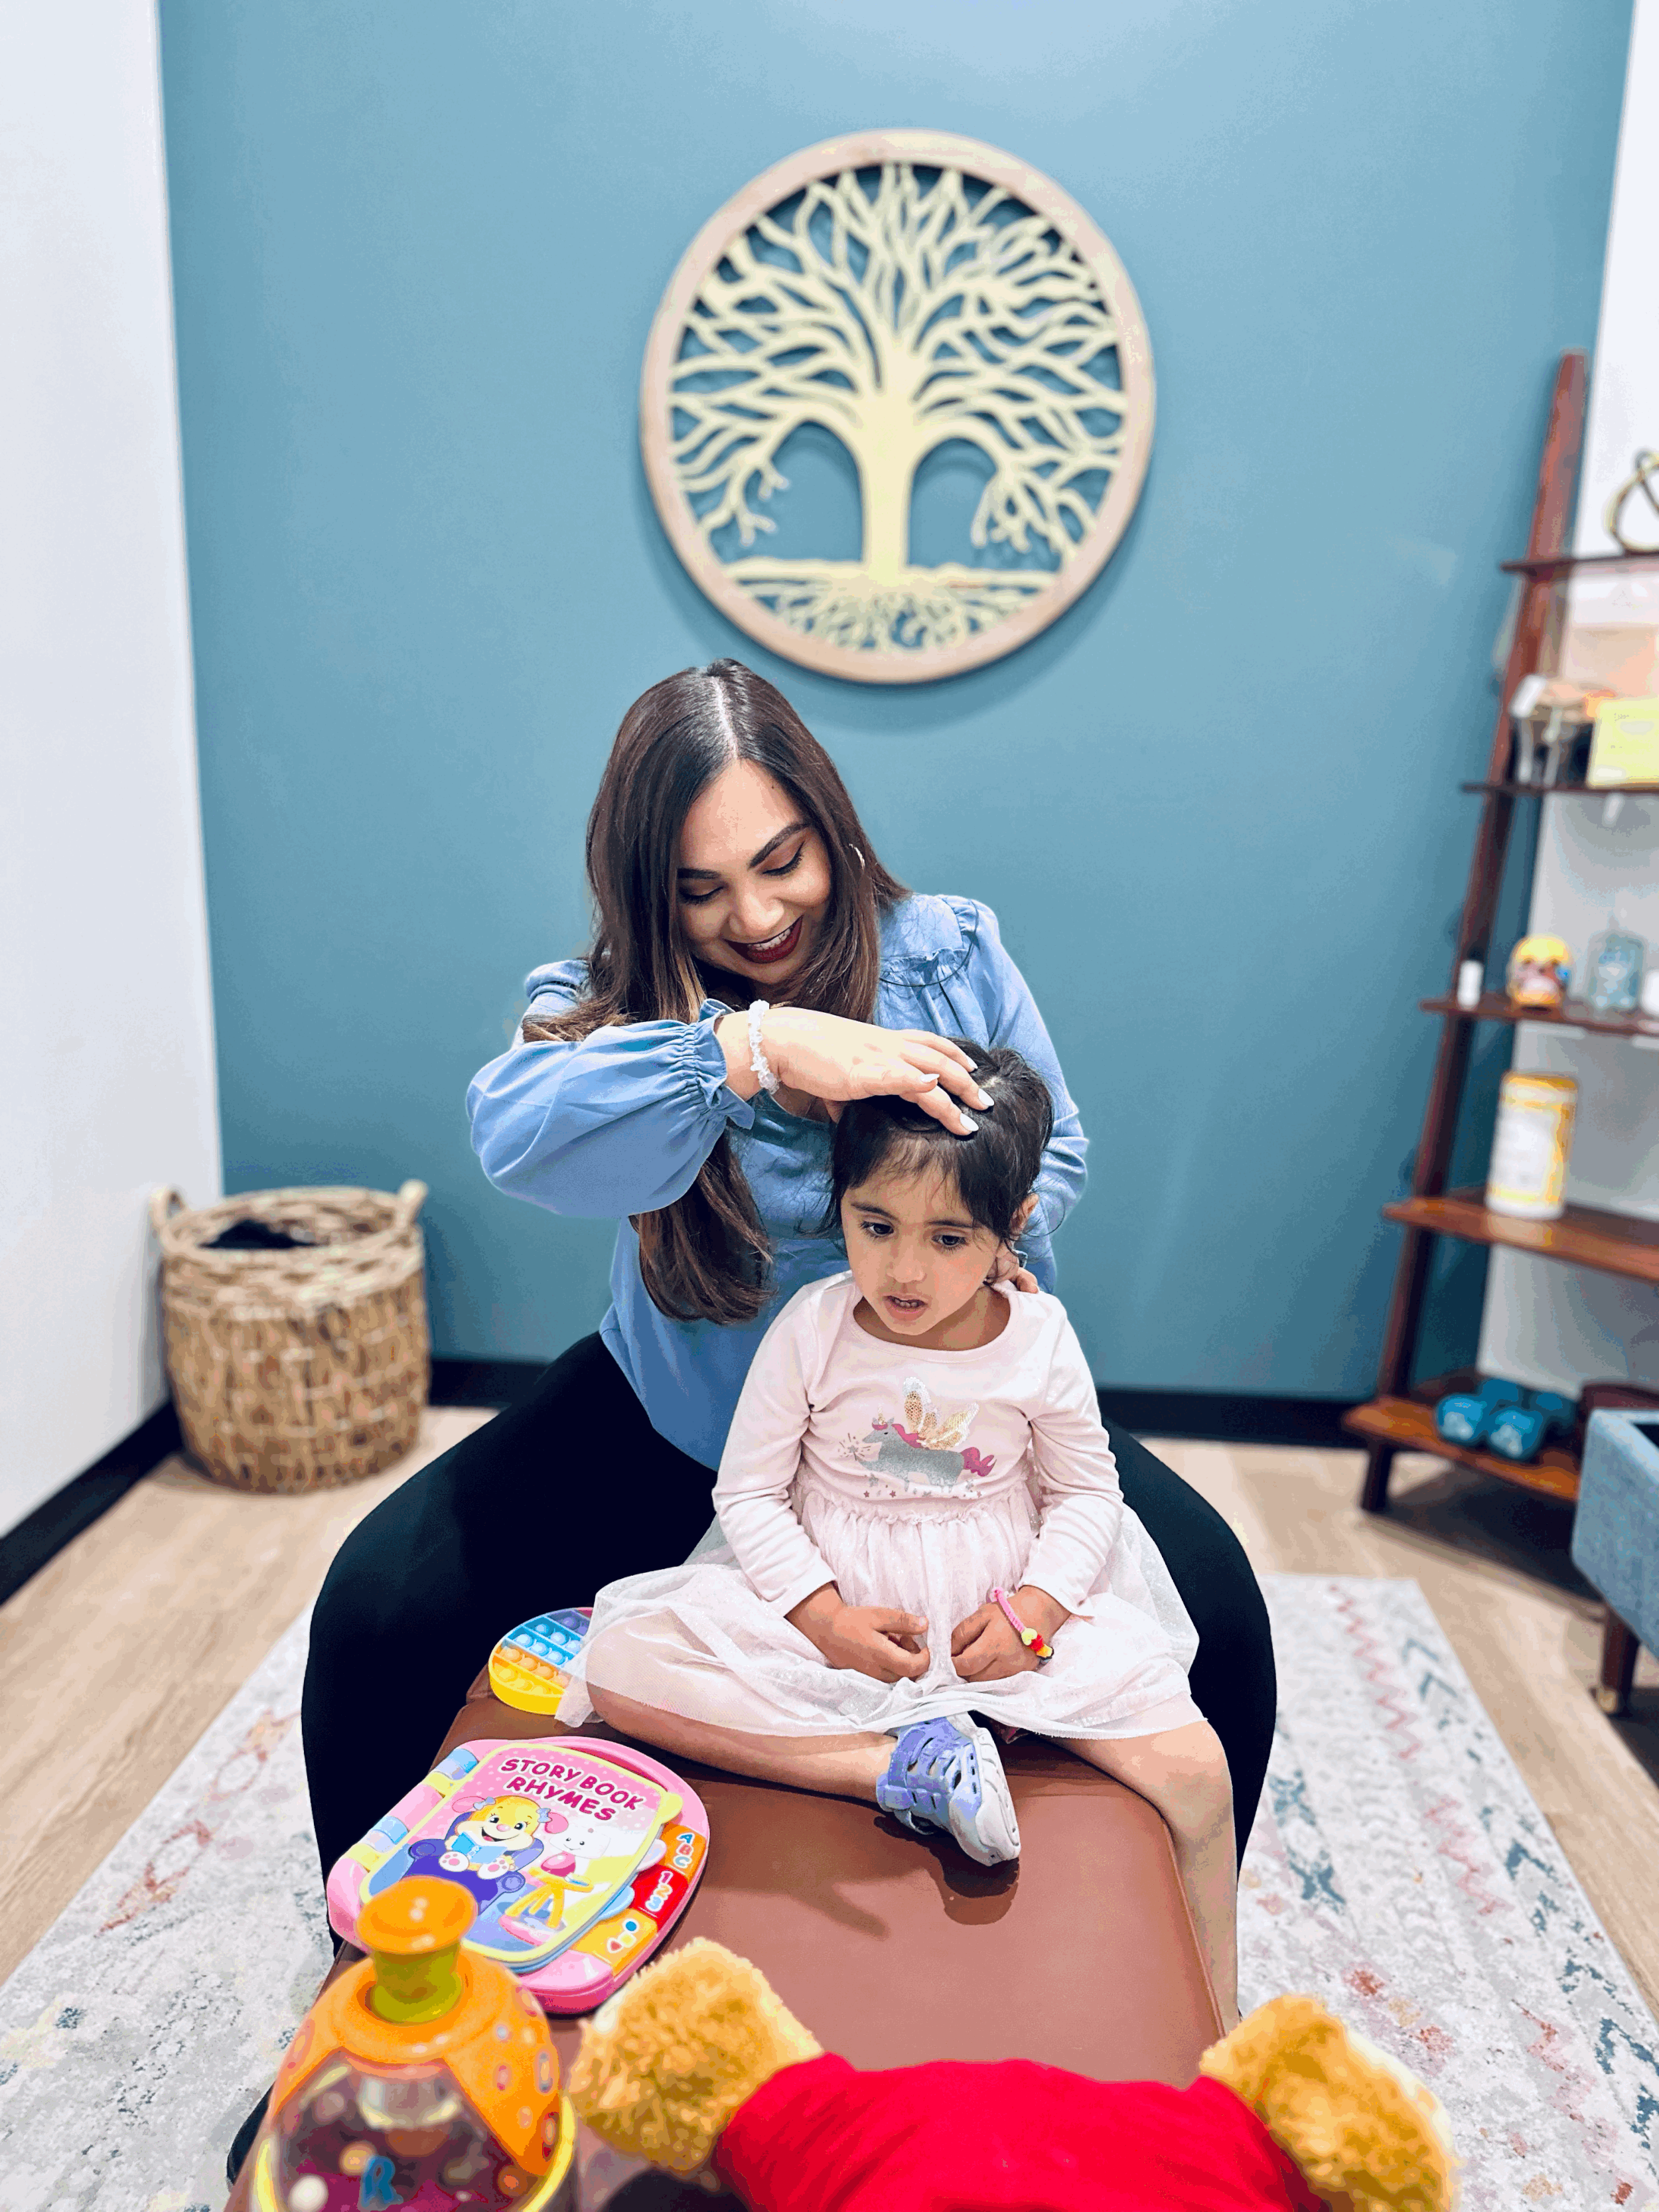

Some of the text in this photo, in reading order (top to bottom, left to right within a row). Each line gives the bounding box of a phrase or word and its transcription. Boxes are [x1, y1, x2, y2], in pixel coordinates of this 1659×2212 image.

[500, 1758, 644, 1810] STORY BOOK
[506, 1776, 616, 1821] RHYMES
